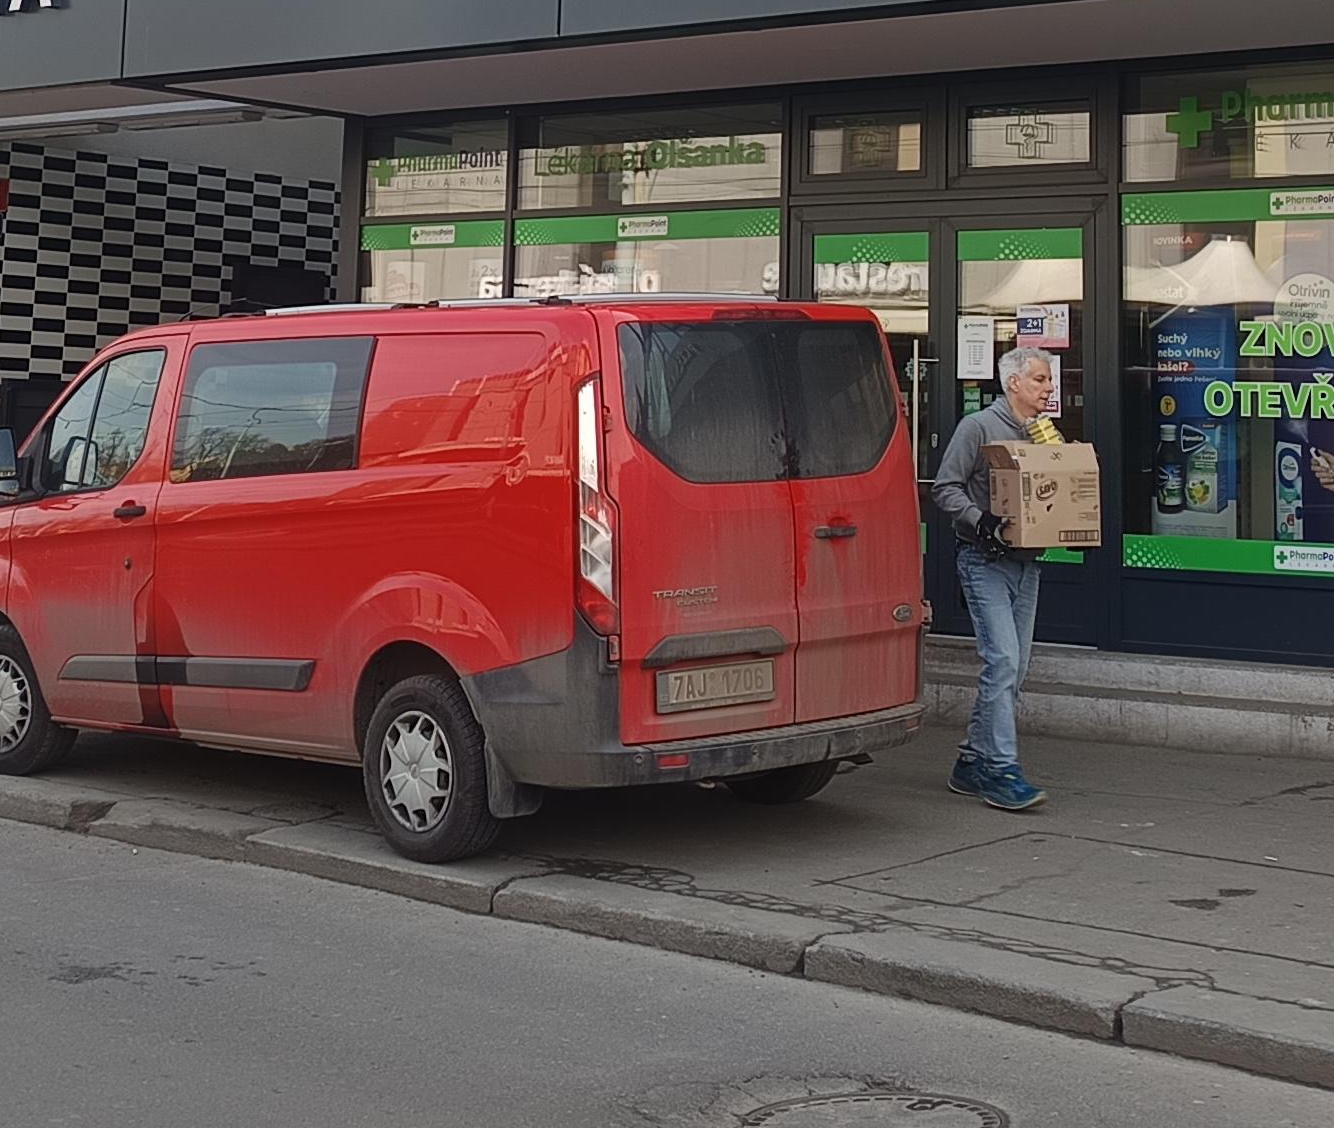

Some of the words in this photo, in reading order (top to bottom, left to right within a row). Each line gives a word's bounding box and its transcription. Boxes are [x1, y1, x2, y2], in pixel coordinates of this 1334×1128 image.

[397, 148, 504, 174] PharmaPoint
[1157, 333, 1188, 345] Suchý
[1157, 347, 1182, 358] nebo
[1185, 347, 1222, 360] vlhký
[651, 585, 718, 600] TRANSIT
[673, 674, 708, 701] 7AJ
[723, 668, 765, 697] 1706
